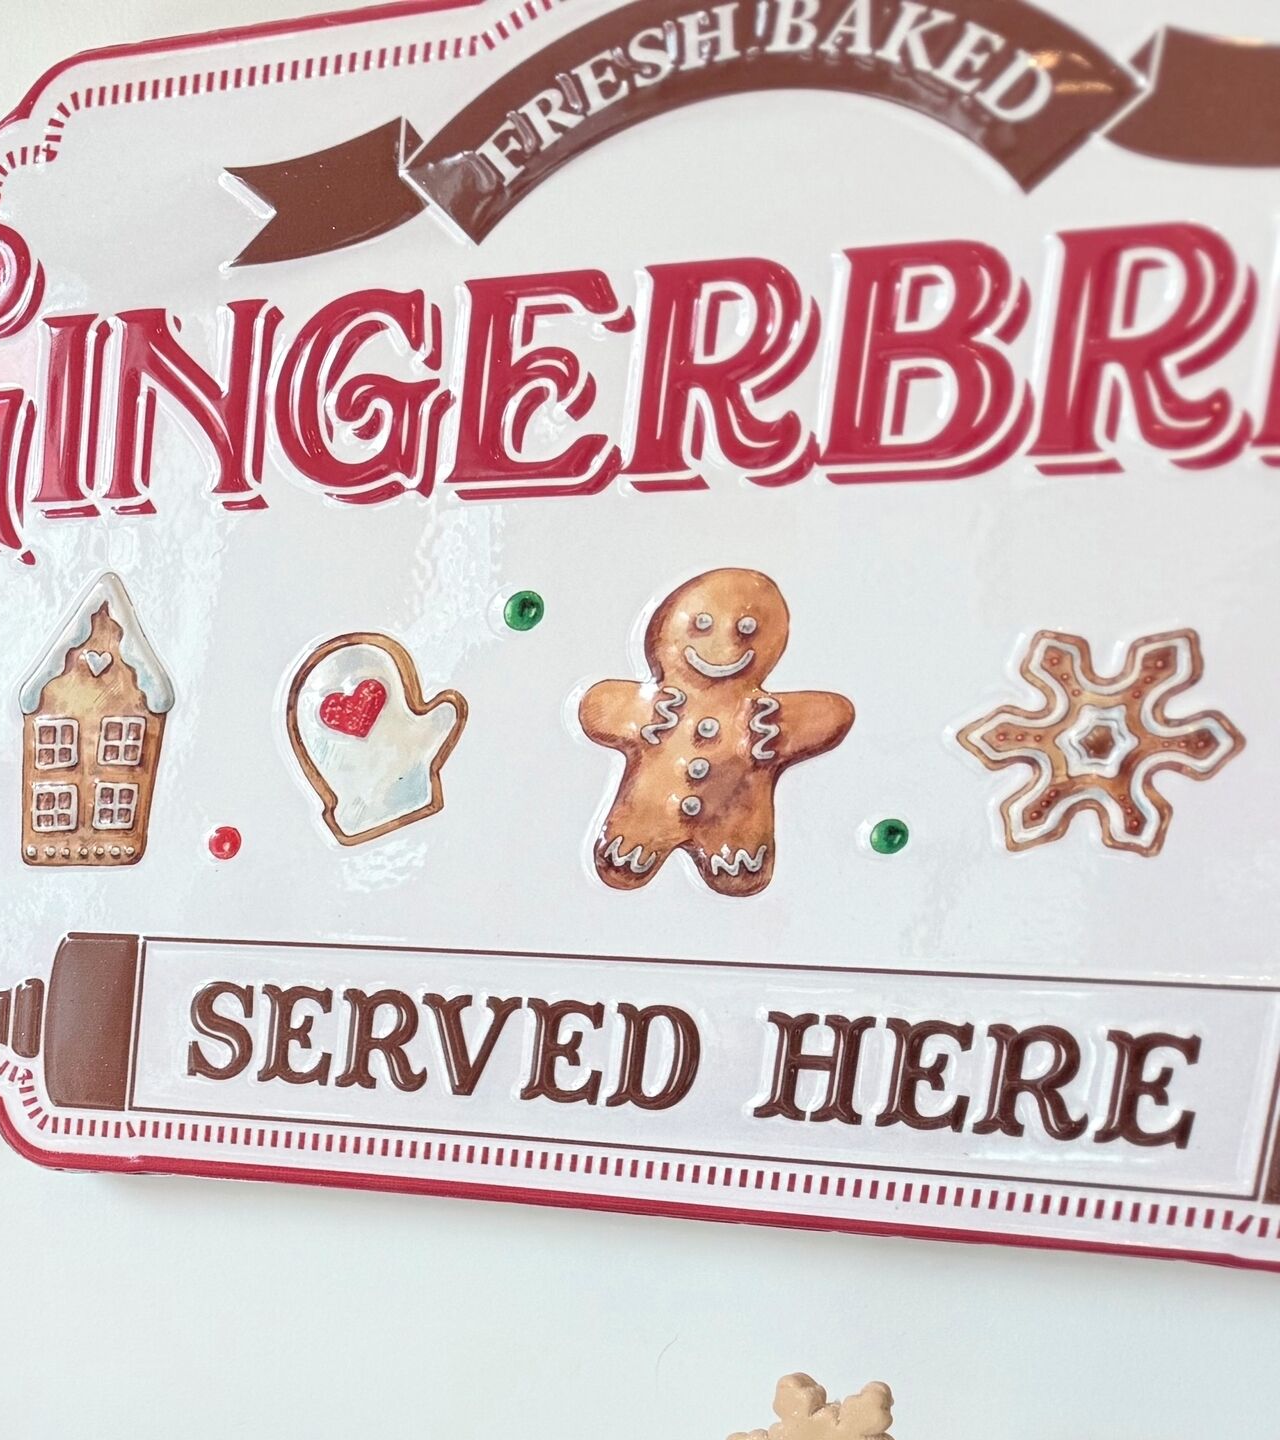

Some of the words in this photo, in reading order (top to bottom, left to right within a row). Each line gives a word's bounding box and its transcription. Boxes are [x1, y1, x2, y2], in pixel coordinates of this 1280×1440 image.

[475, 3, 741, 187] FRESH
[765, 0, 1053, 122] BAKED
[187, 980, 702, 1111] SERVED
[752, 1010, 1203, 1150] HERE
